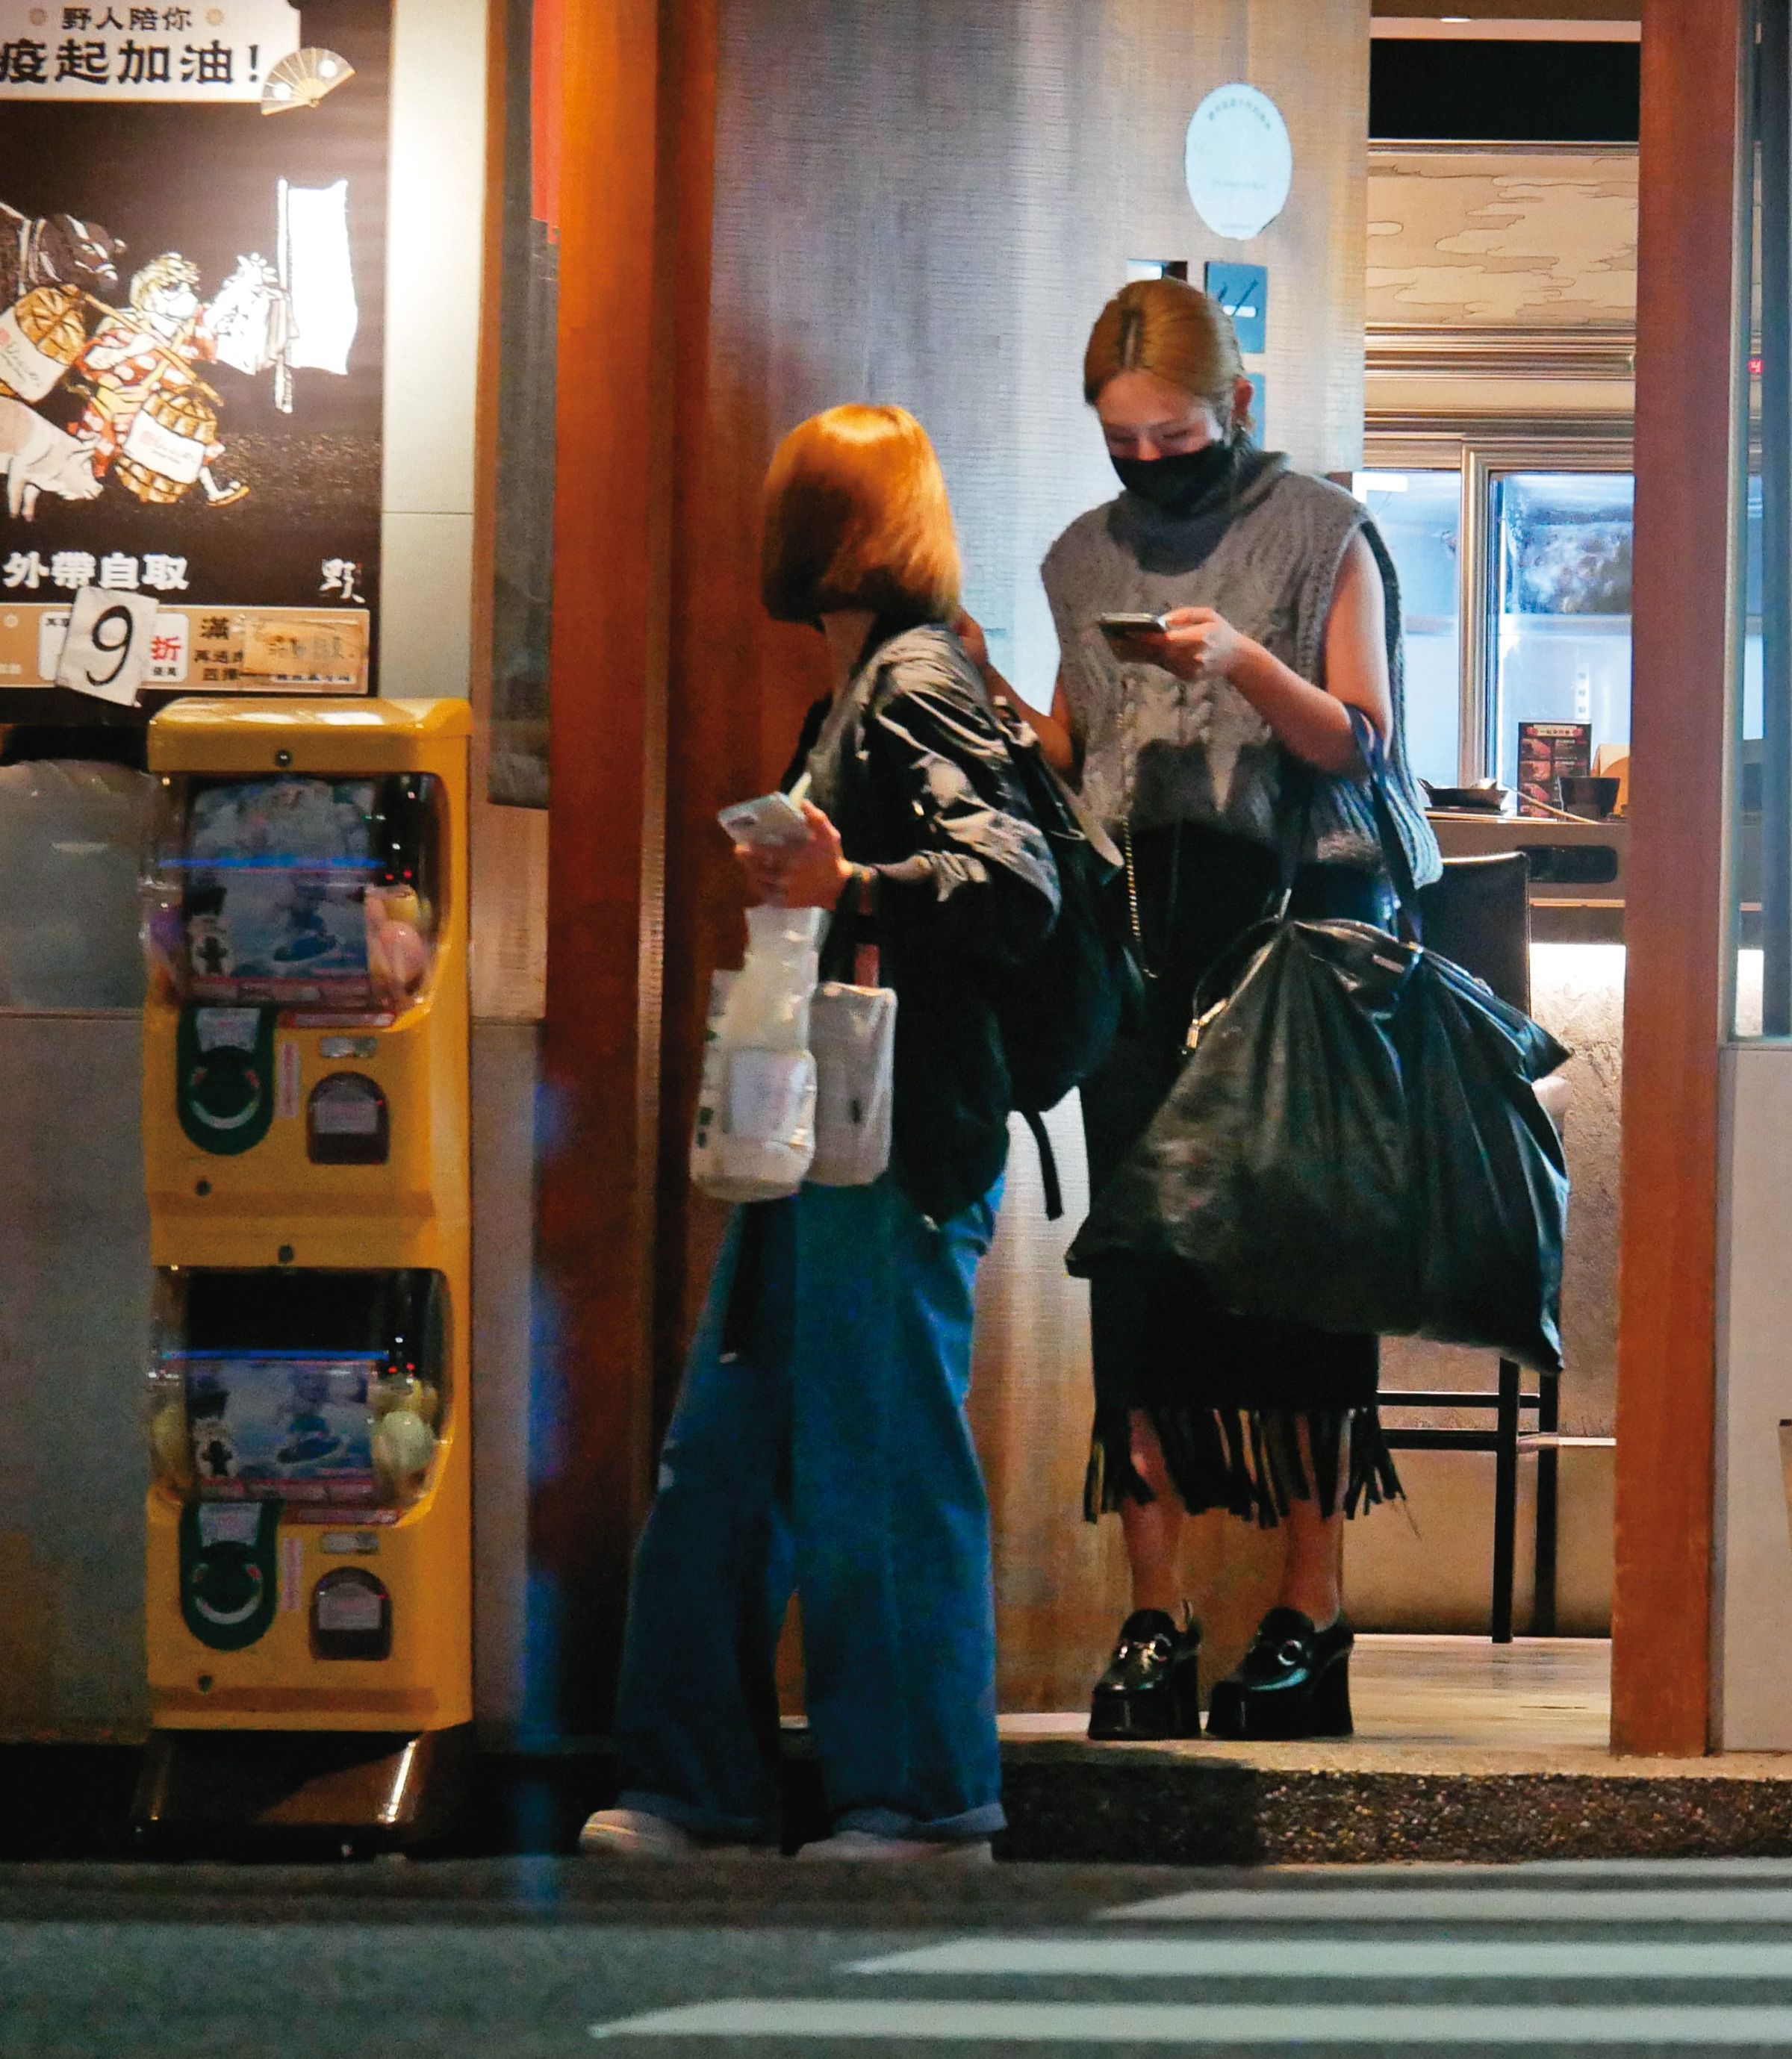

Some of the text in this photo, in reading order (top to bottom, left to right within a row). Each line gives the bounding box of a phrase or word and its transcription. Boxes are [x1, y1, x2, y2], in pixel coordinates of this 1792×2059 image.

[62, 7, 192, 31] 野人陪你
[0, 38, 260, 84] 疫起加油!
[2, 551, 189, 591] 外帶自取
[86, 605, 133, 687] 9
[151, 635, 181, 661] 折
